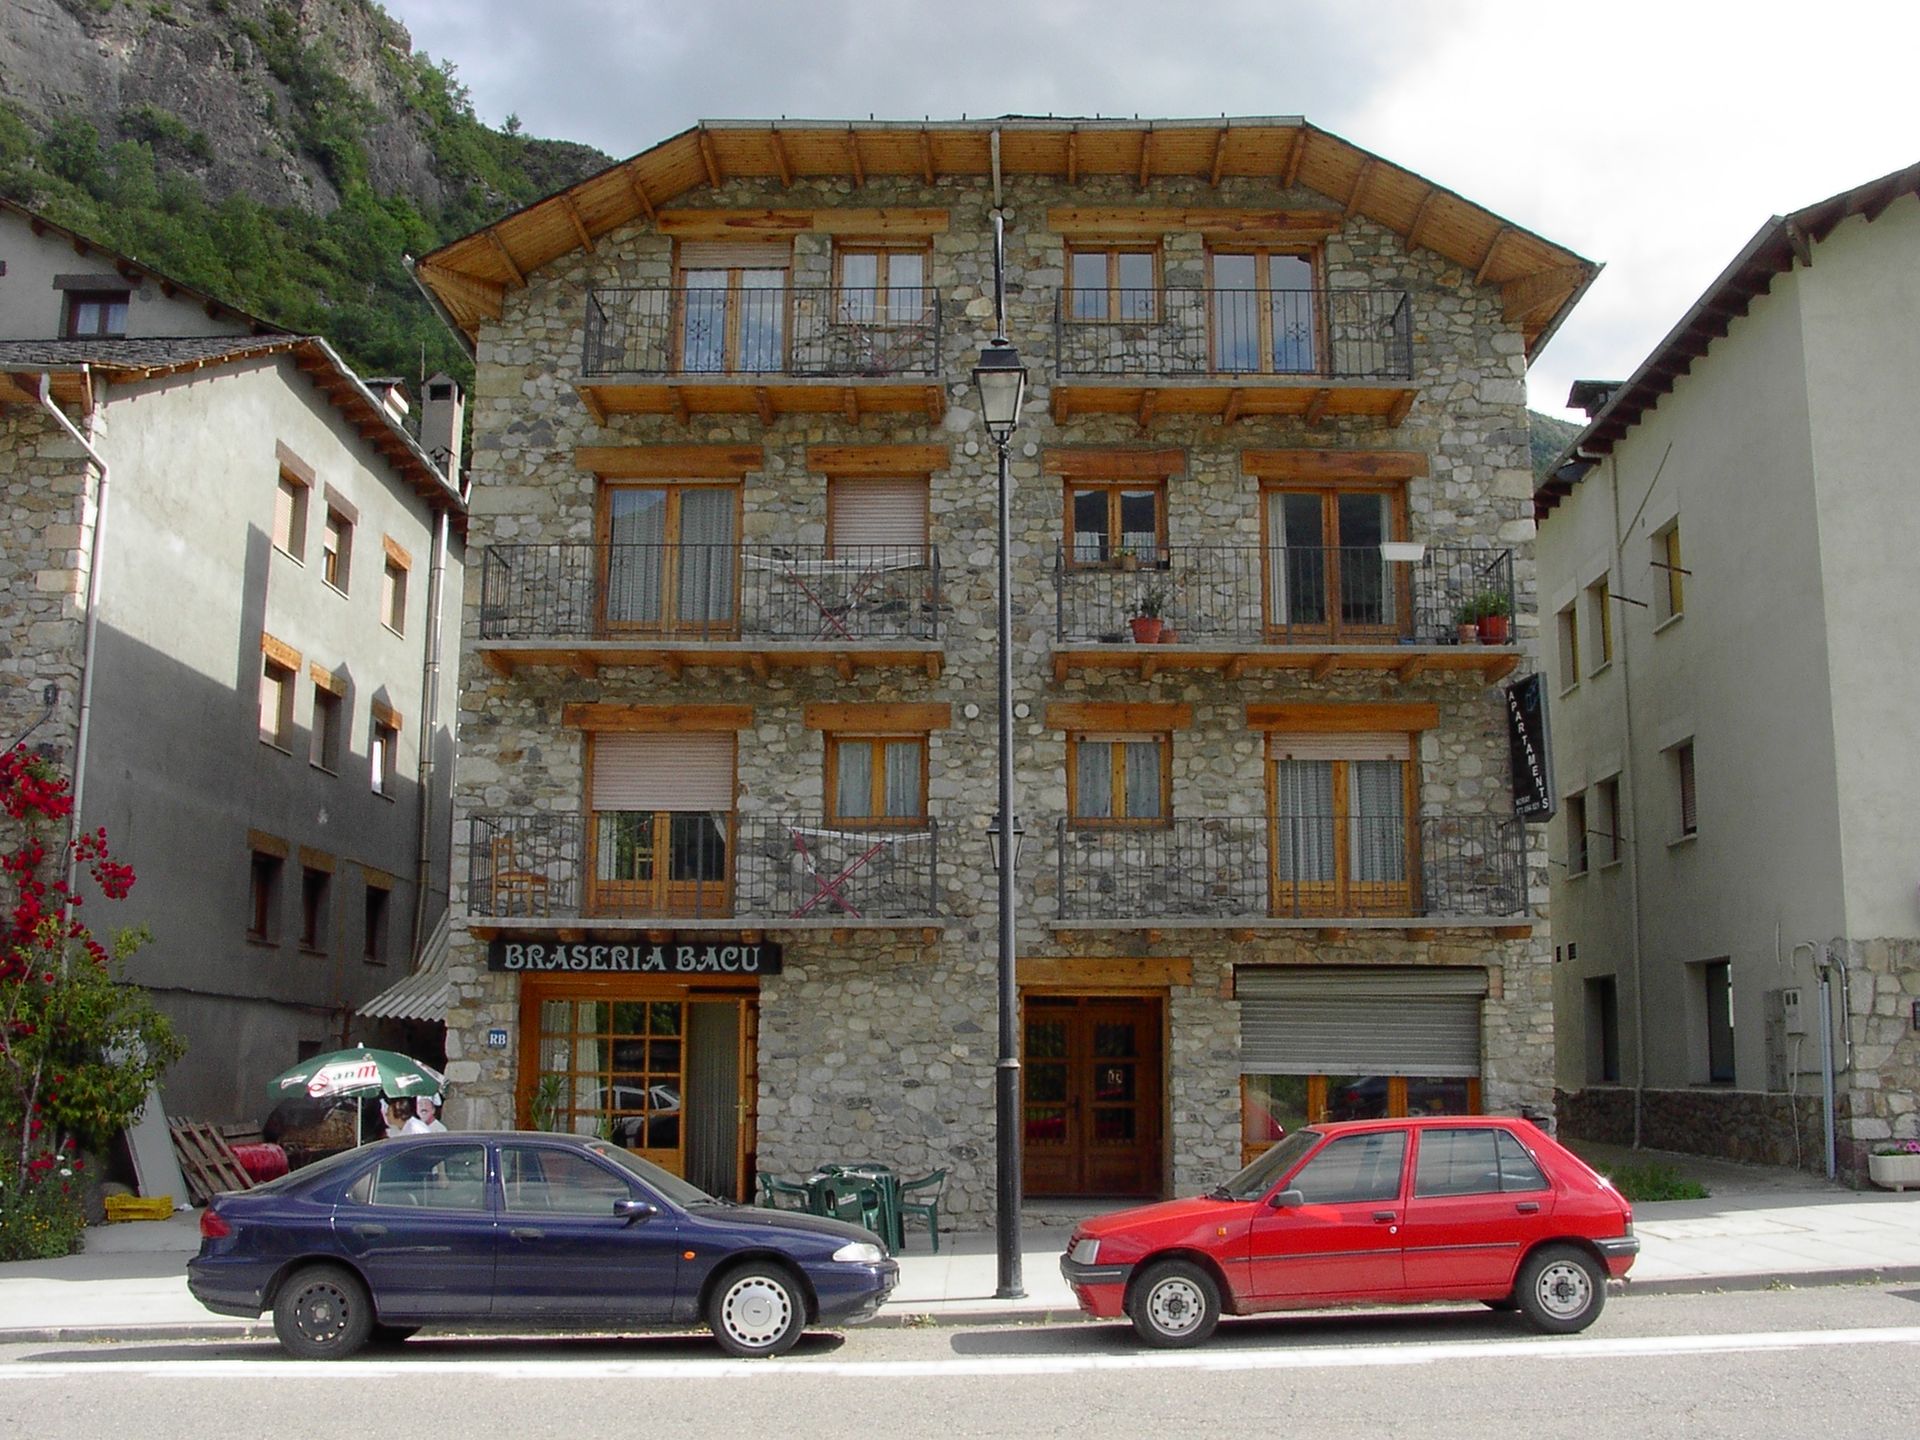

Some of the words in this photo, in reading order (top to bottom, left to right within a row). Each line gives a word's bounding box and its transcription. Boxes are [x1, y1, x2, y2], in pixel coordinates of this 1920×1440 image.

[1508, 691, 1549, 809] APARTAMENTS
[504, 943, 667, 971] BRASERIA
[676, 945, 760, 972] BACU
[490, 1033, 506, 1045] RB
